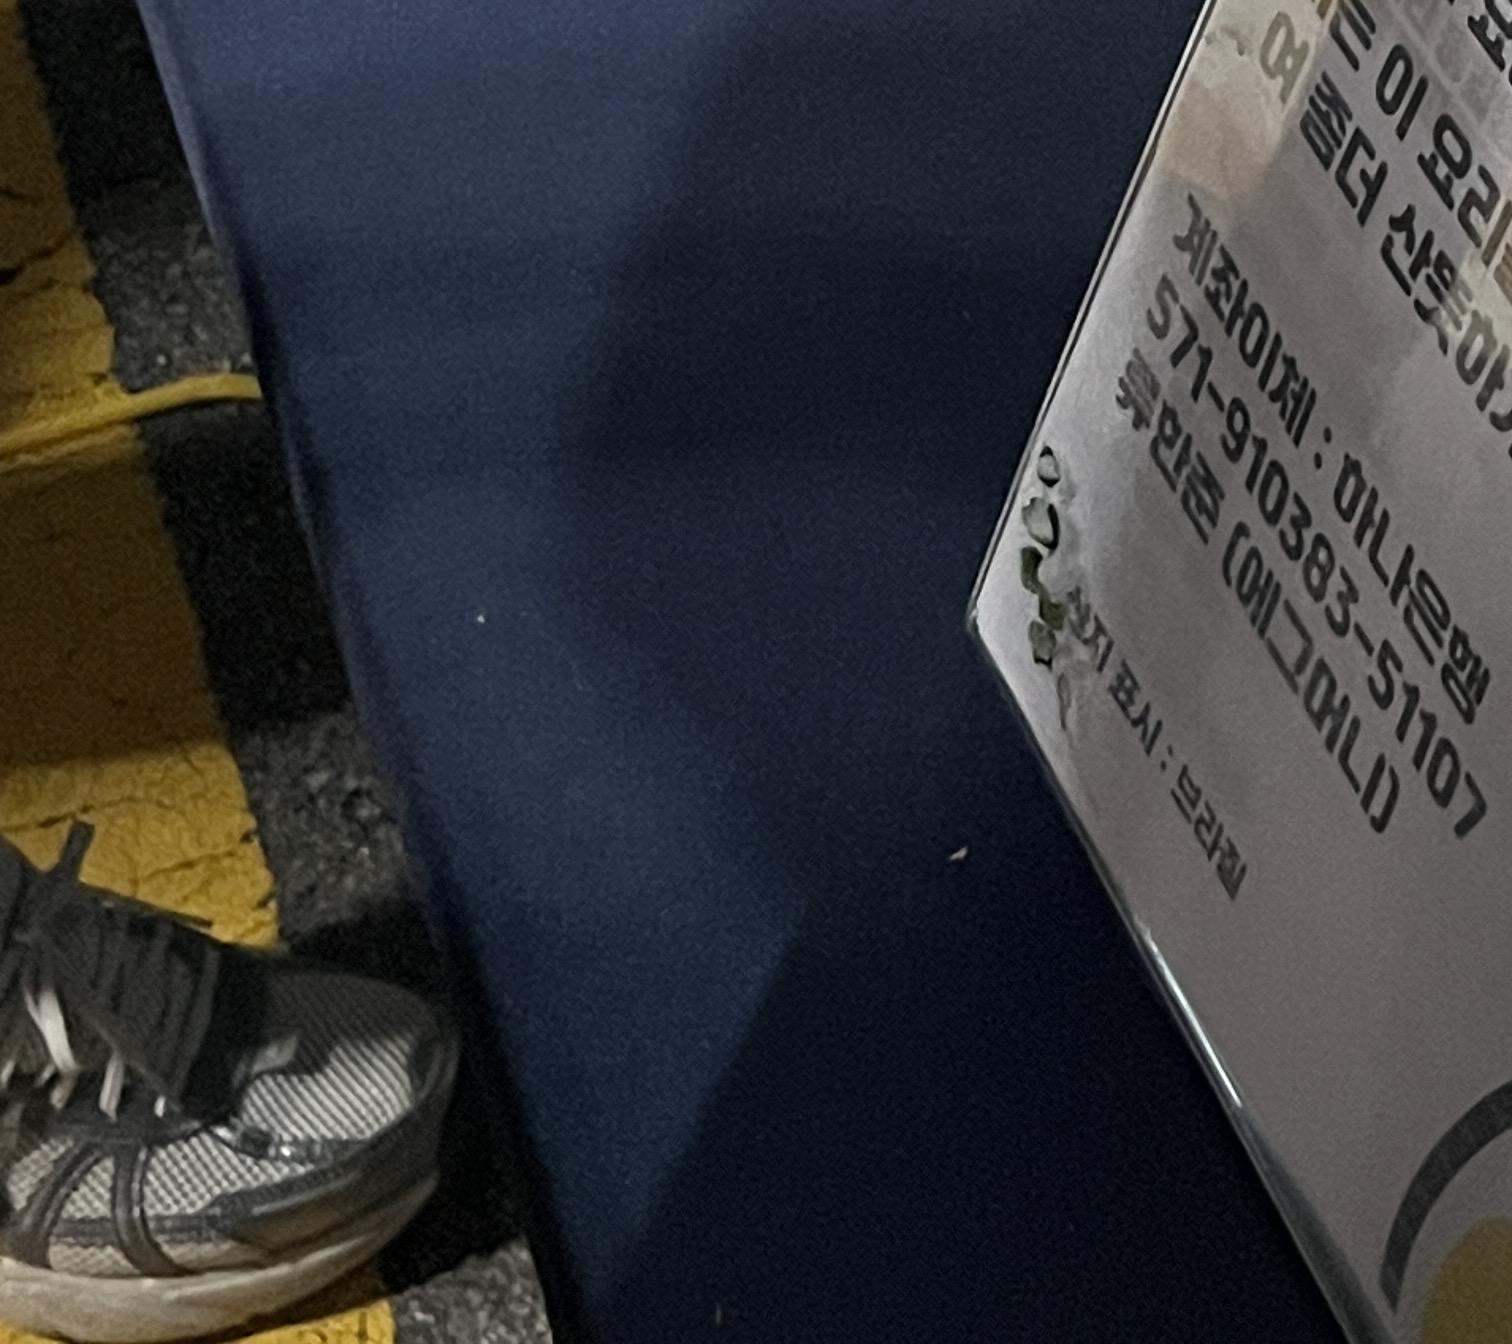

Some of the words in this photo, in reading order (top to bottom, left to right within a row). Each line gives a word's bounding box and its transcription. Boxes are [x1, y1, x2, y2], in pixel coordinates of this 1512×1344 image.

[1258, 10, 1310, 105] 여
[1298, 69, 1388, 228] 좀더
[1374, 42, 1429, 142] 이
[1145, 272, 1487, 839] 571-910383-51107
[1171, 191, 1317, 448] 계좌이체
[1332, 451, 1491, 725] 하나은행
[1106, 657, 1163, 757] 표시
[1169, 763, 1247, 901] 브라질
[1220, 520, 1400, 834] (에그머니)
